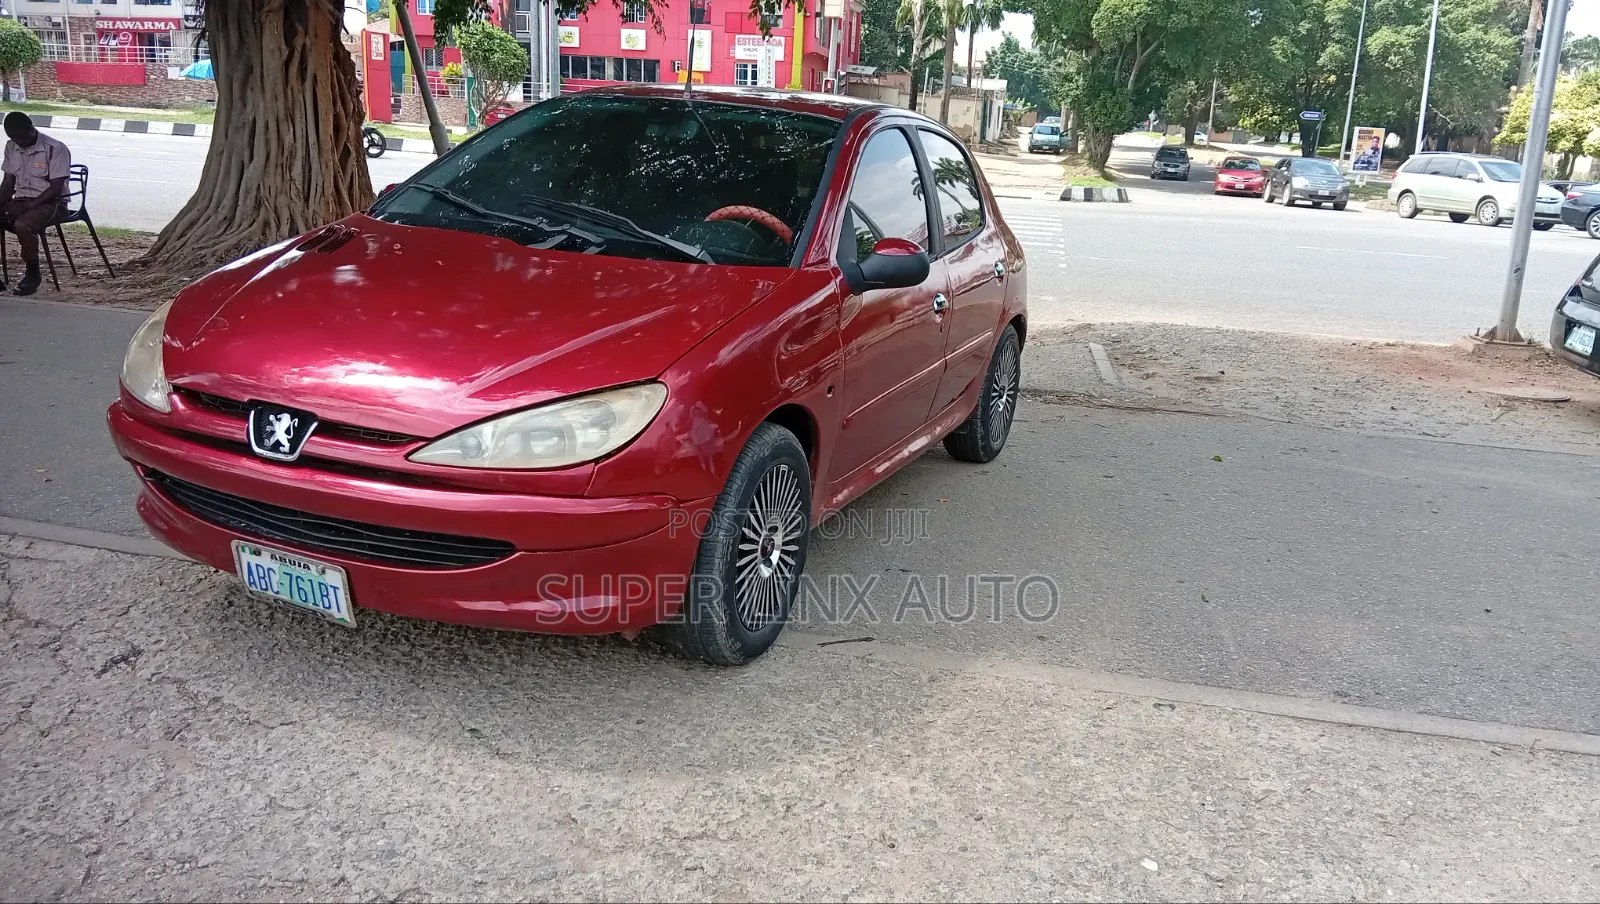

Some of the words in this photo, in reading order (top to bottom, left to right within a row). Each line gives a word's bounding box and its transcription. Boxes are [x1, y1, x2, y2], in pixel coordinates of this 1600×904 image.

[95, 20, 177, 30] SHAWARMA
[270, 553, 312, 571] ABUJA
[246, 561, 340, 614] ABC-761BT
